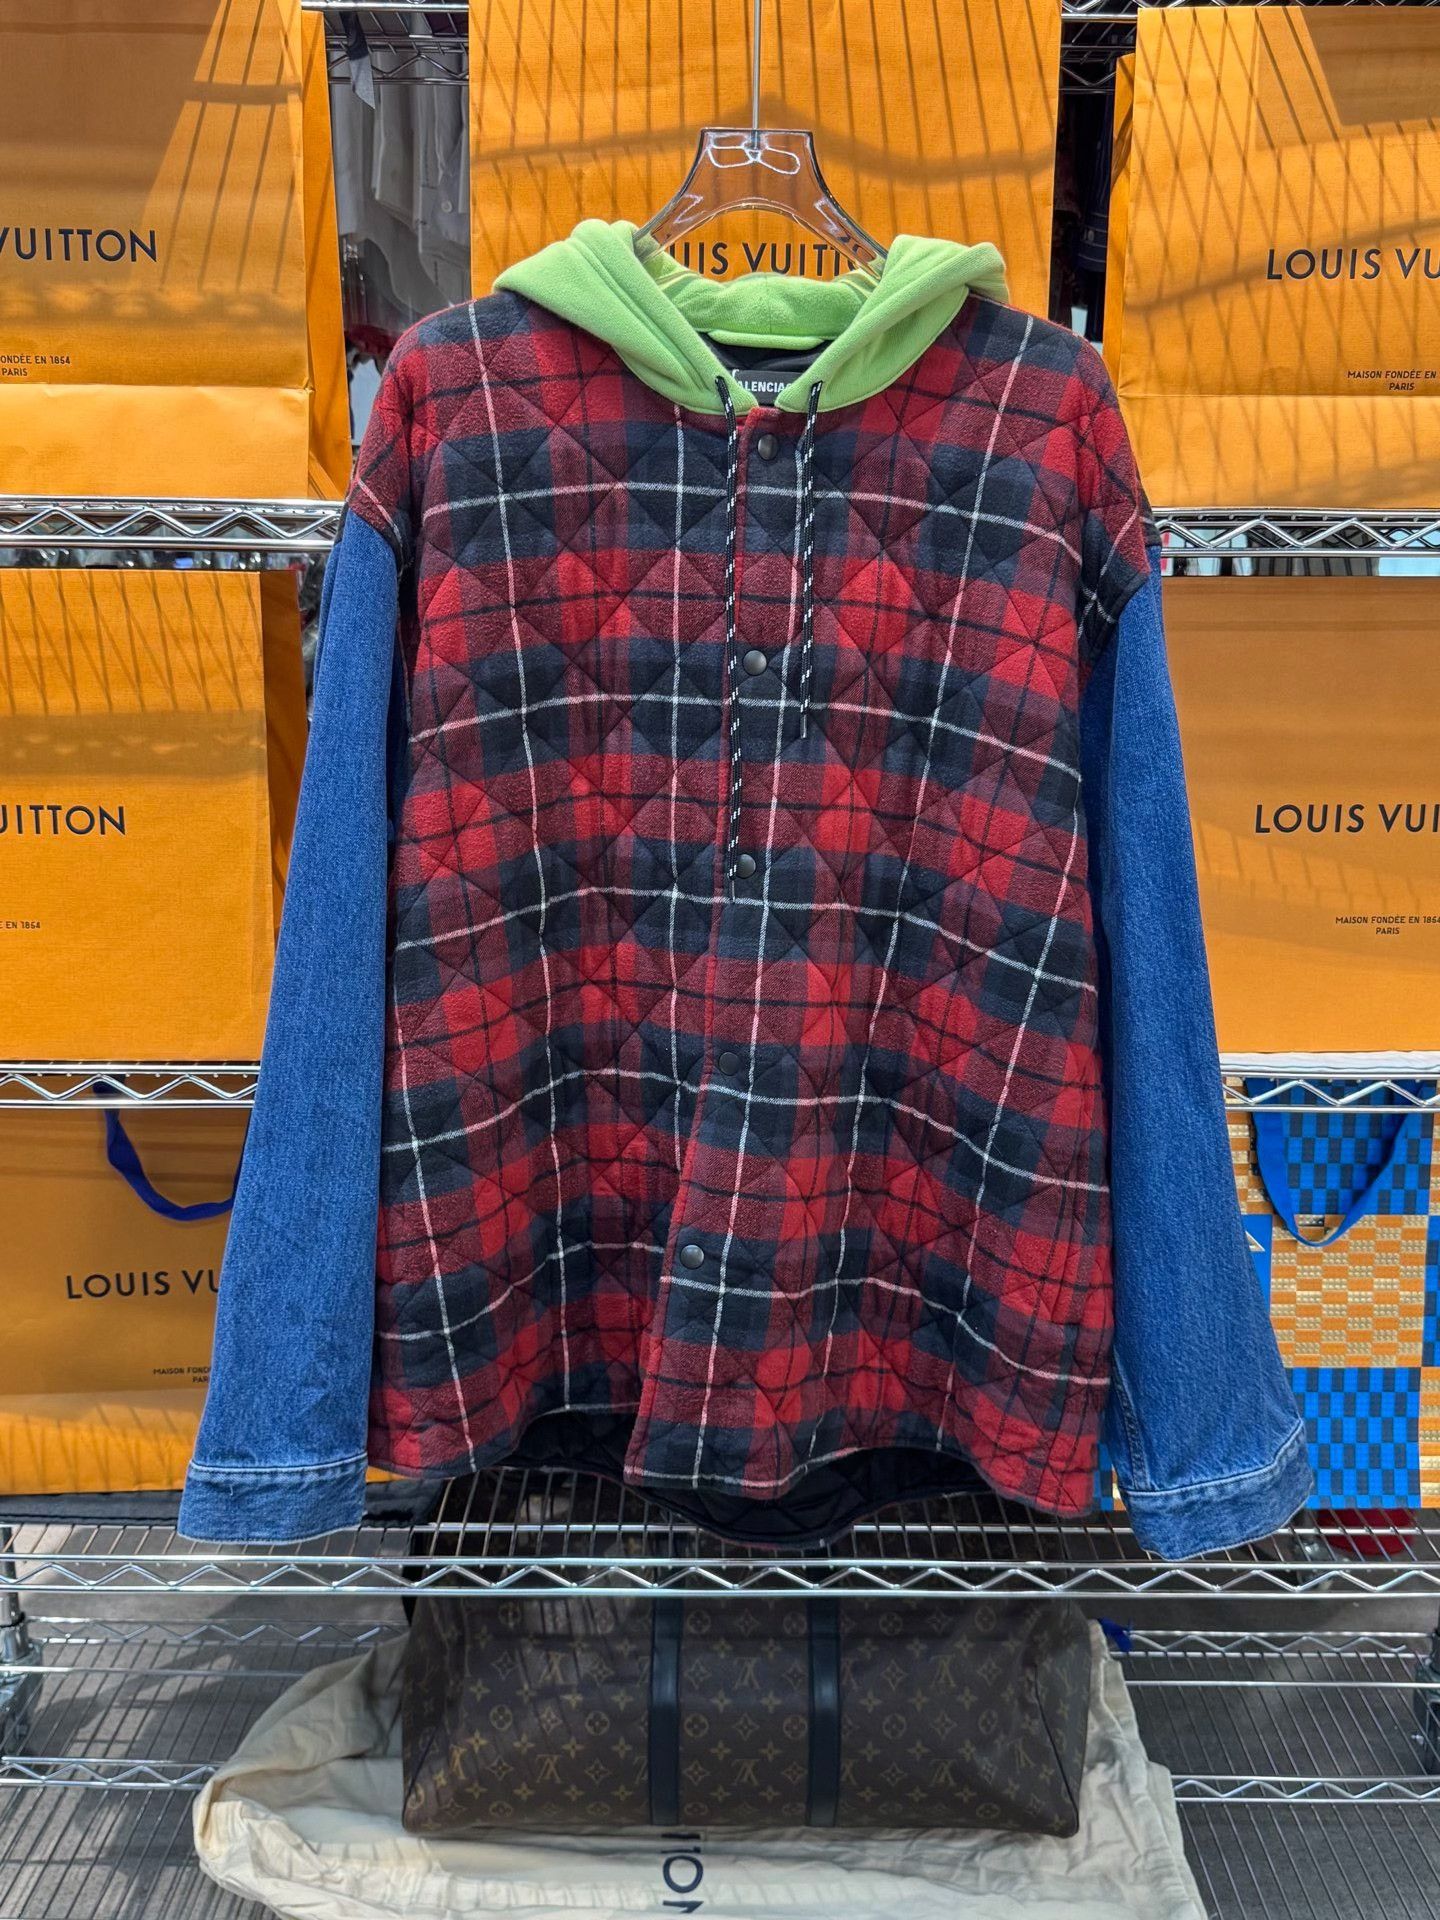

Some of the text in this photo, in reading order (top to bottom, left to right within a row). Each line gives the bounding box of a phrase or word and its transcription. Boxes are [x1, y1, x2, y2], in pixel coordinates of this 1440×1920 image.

[1266, 248, 1382, 280] LOUIS
[35, 355, 47, 364] EN
[50, 355, 71, 365] 1854
[2, 367, 28, 377] PARIS
[1347, 368, 1437, 379] MAISON FONDÉE EN
[1389, 382, 1415, 391] PARIS
[1255, 803, 1365, 834] LOUIS
[1335, 916, 1368, 924] MAISON
[1371, 914, 1406, 924] FONDÉE
[1408, 916, 1419, 924] EN
[5, 920, 18, 929] EN
[20, 920, 41, 929] 1854
[1375, 927, 1400, 935] PARIS
[66, 1271, 171, 1300] LOUIS
[153, 1367, 185, 1375] MAISON
